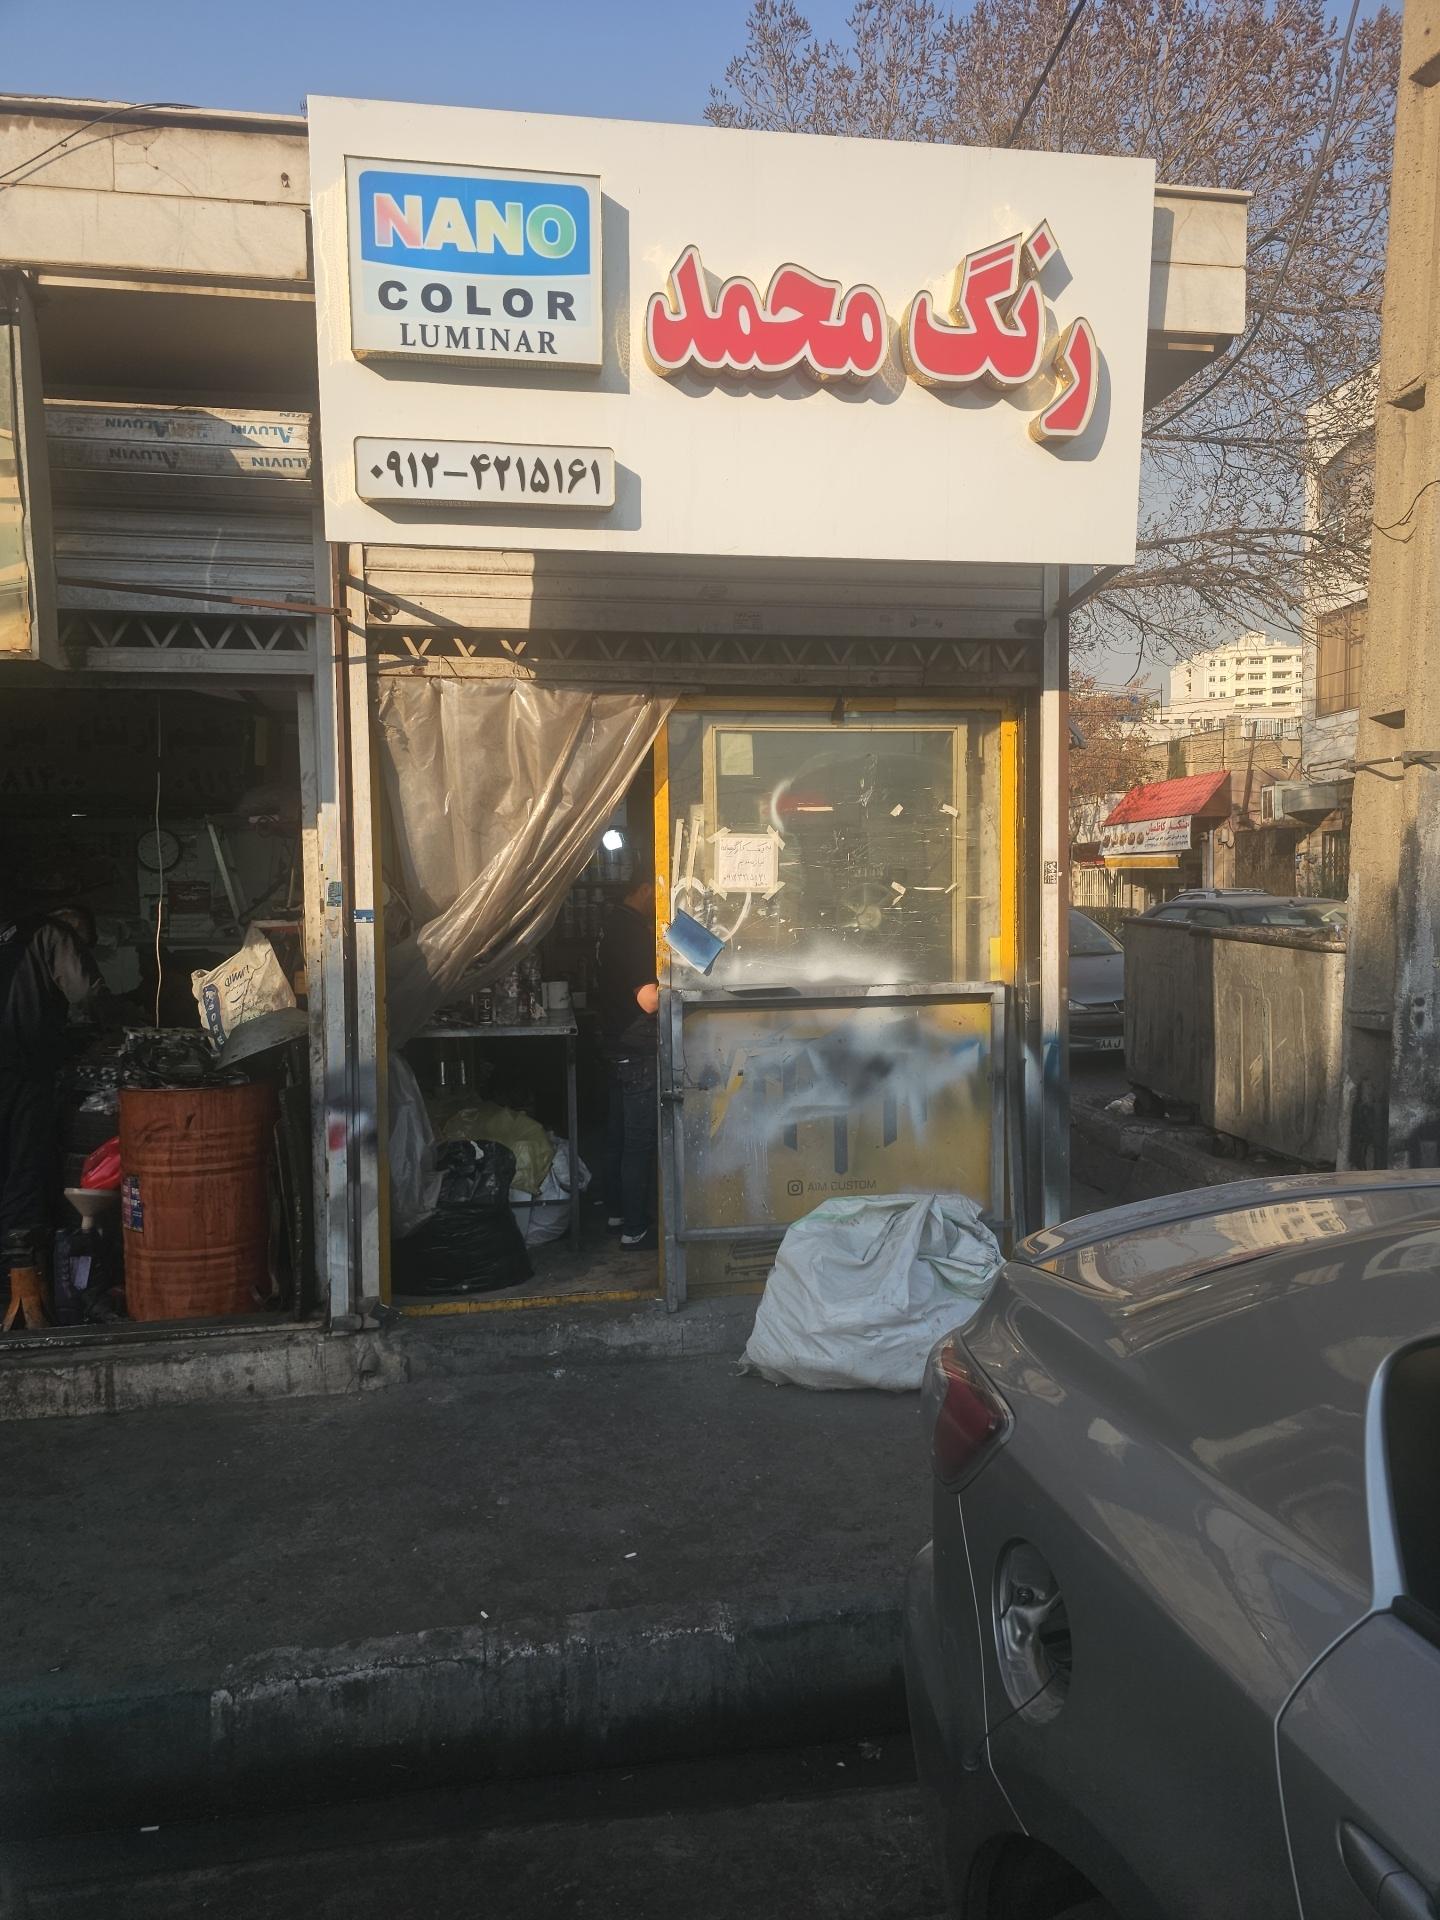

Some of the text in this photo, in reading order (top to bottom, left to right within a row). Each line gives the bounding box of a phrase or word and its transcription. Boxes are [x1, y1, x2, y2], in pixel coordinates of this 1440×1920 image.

[373, 192, 577, 259] NANO
[378, 280, 576, 321] COLOR
[400, 322, 557, 354] LUMINAR
[646, 219, 1100, 438] رنگ محمد
[232, 424, 294, 443] ALUVIN
[370, 450, 602, 495] ۰۹۱۲-۴۲۱۵۱۶۱
